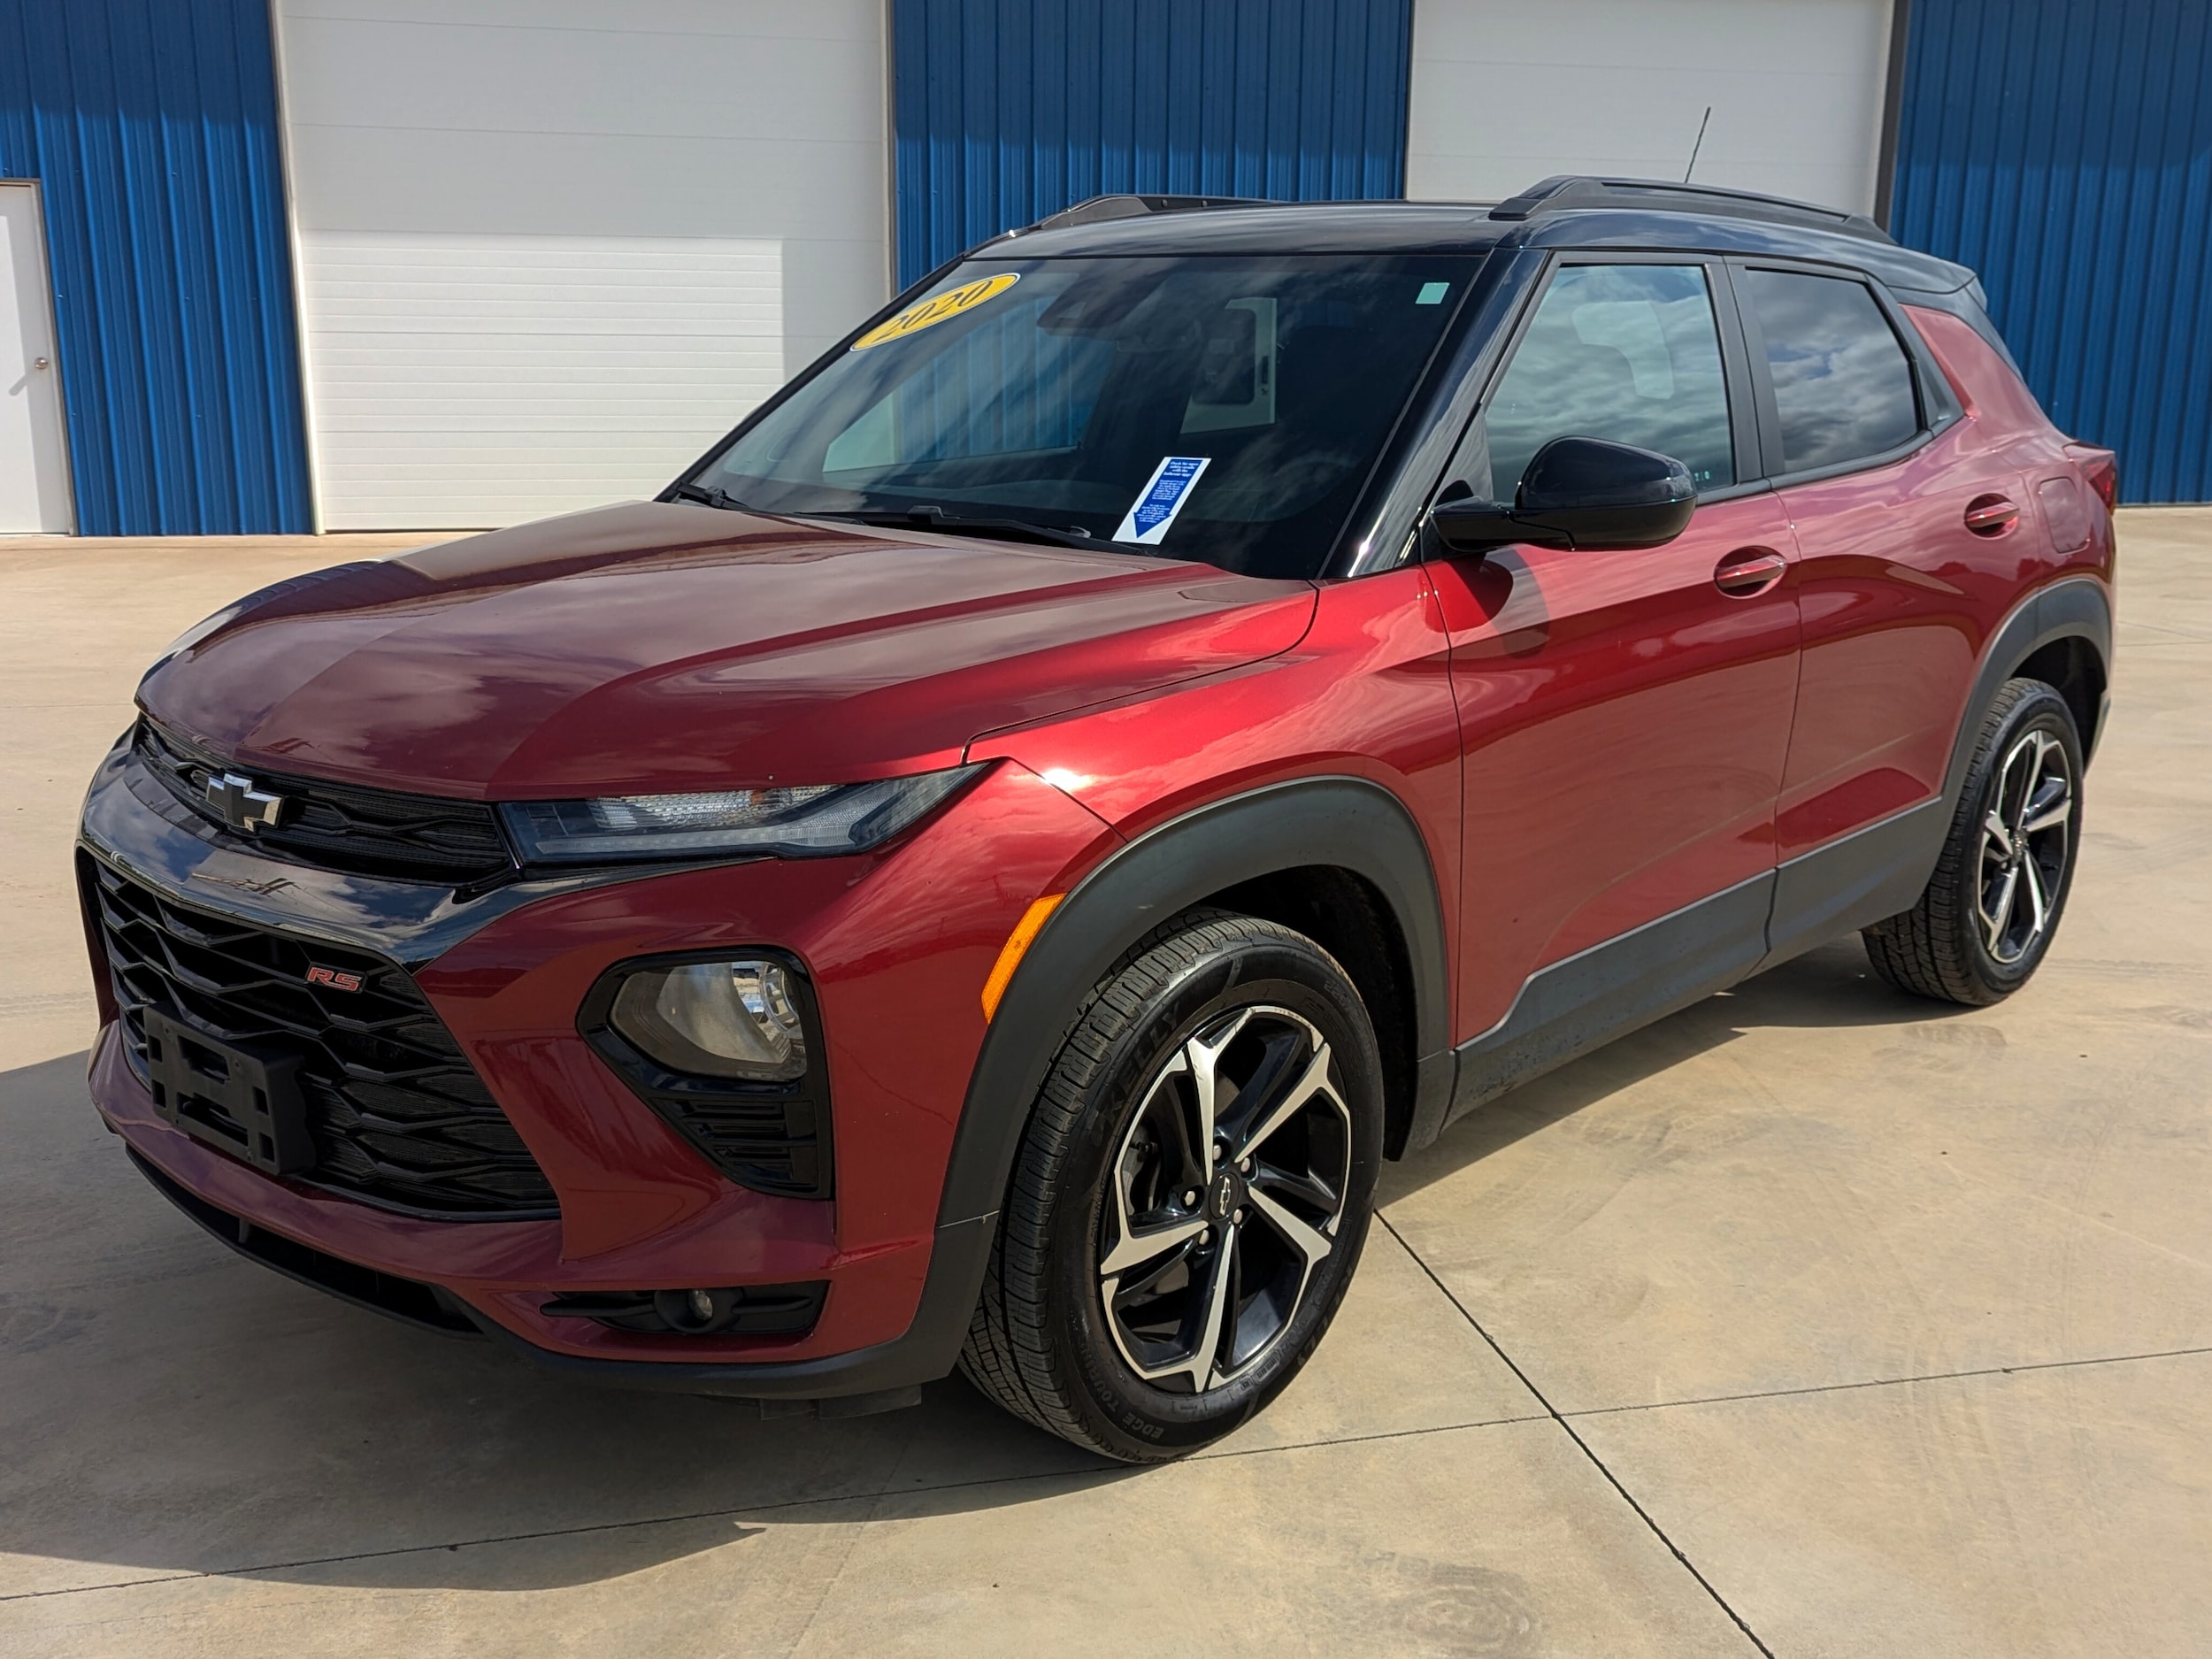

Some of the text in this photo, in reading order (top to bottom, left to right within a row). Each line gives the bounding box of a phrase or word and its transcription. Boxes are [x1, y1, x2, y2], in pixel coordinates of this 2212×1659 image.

[871, 280, 994, 344] 2020
[306, 966, 363, 992] RS
[1100, 1002, 1180, 1125] KELLY
[1122, 1411, 1164, 1440] EDGE
